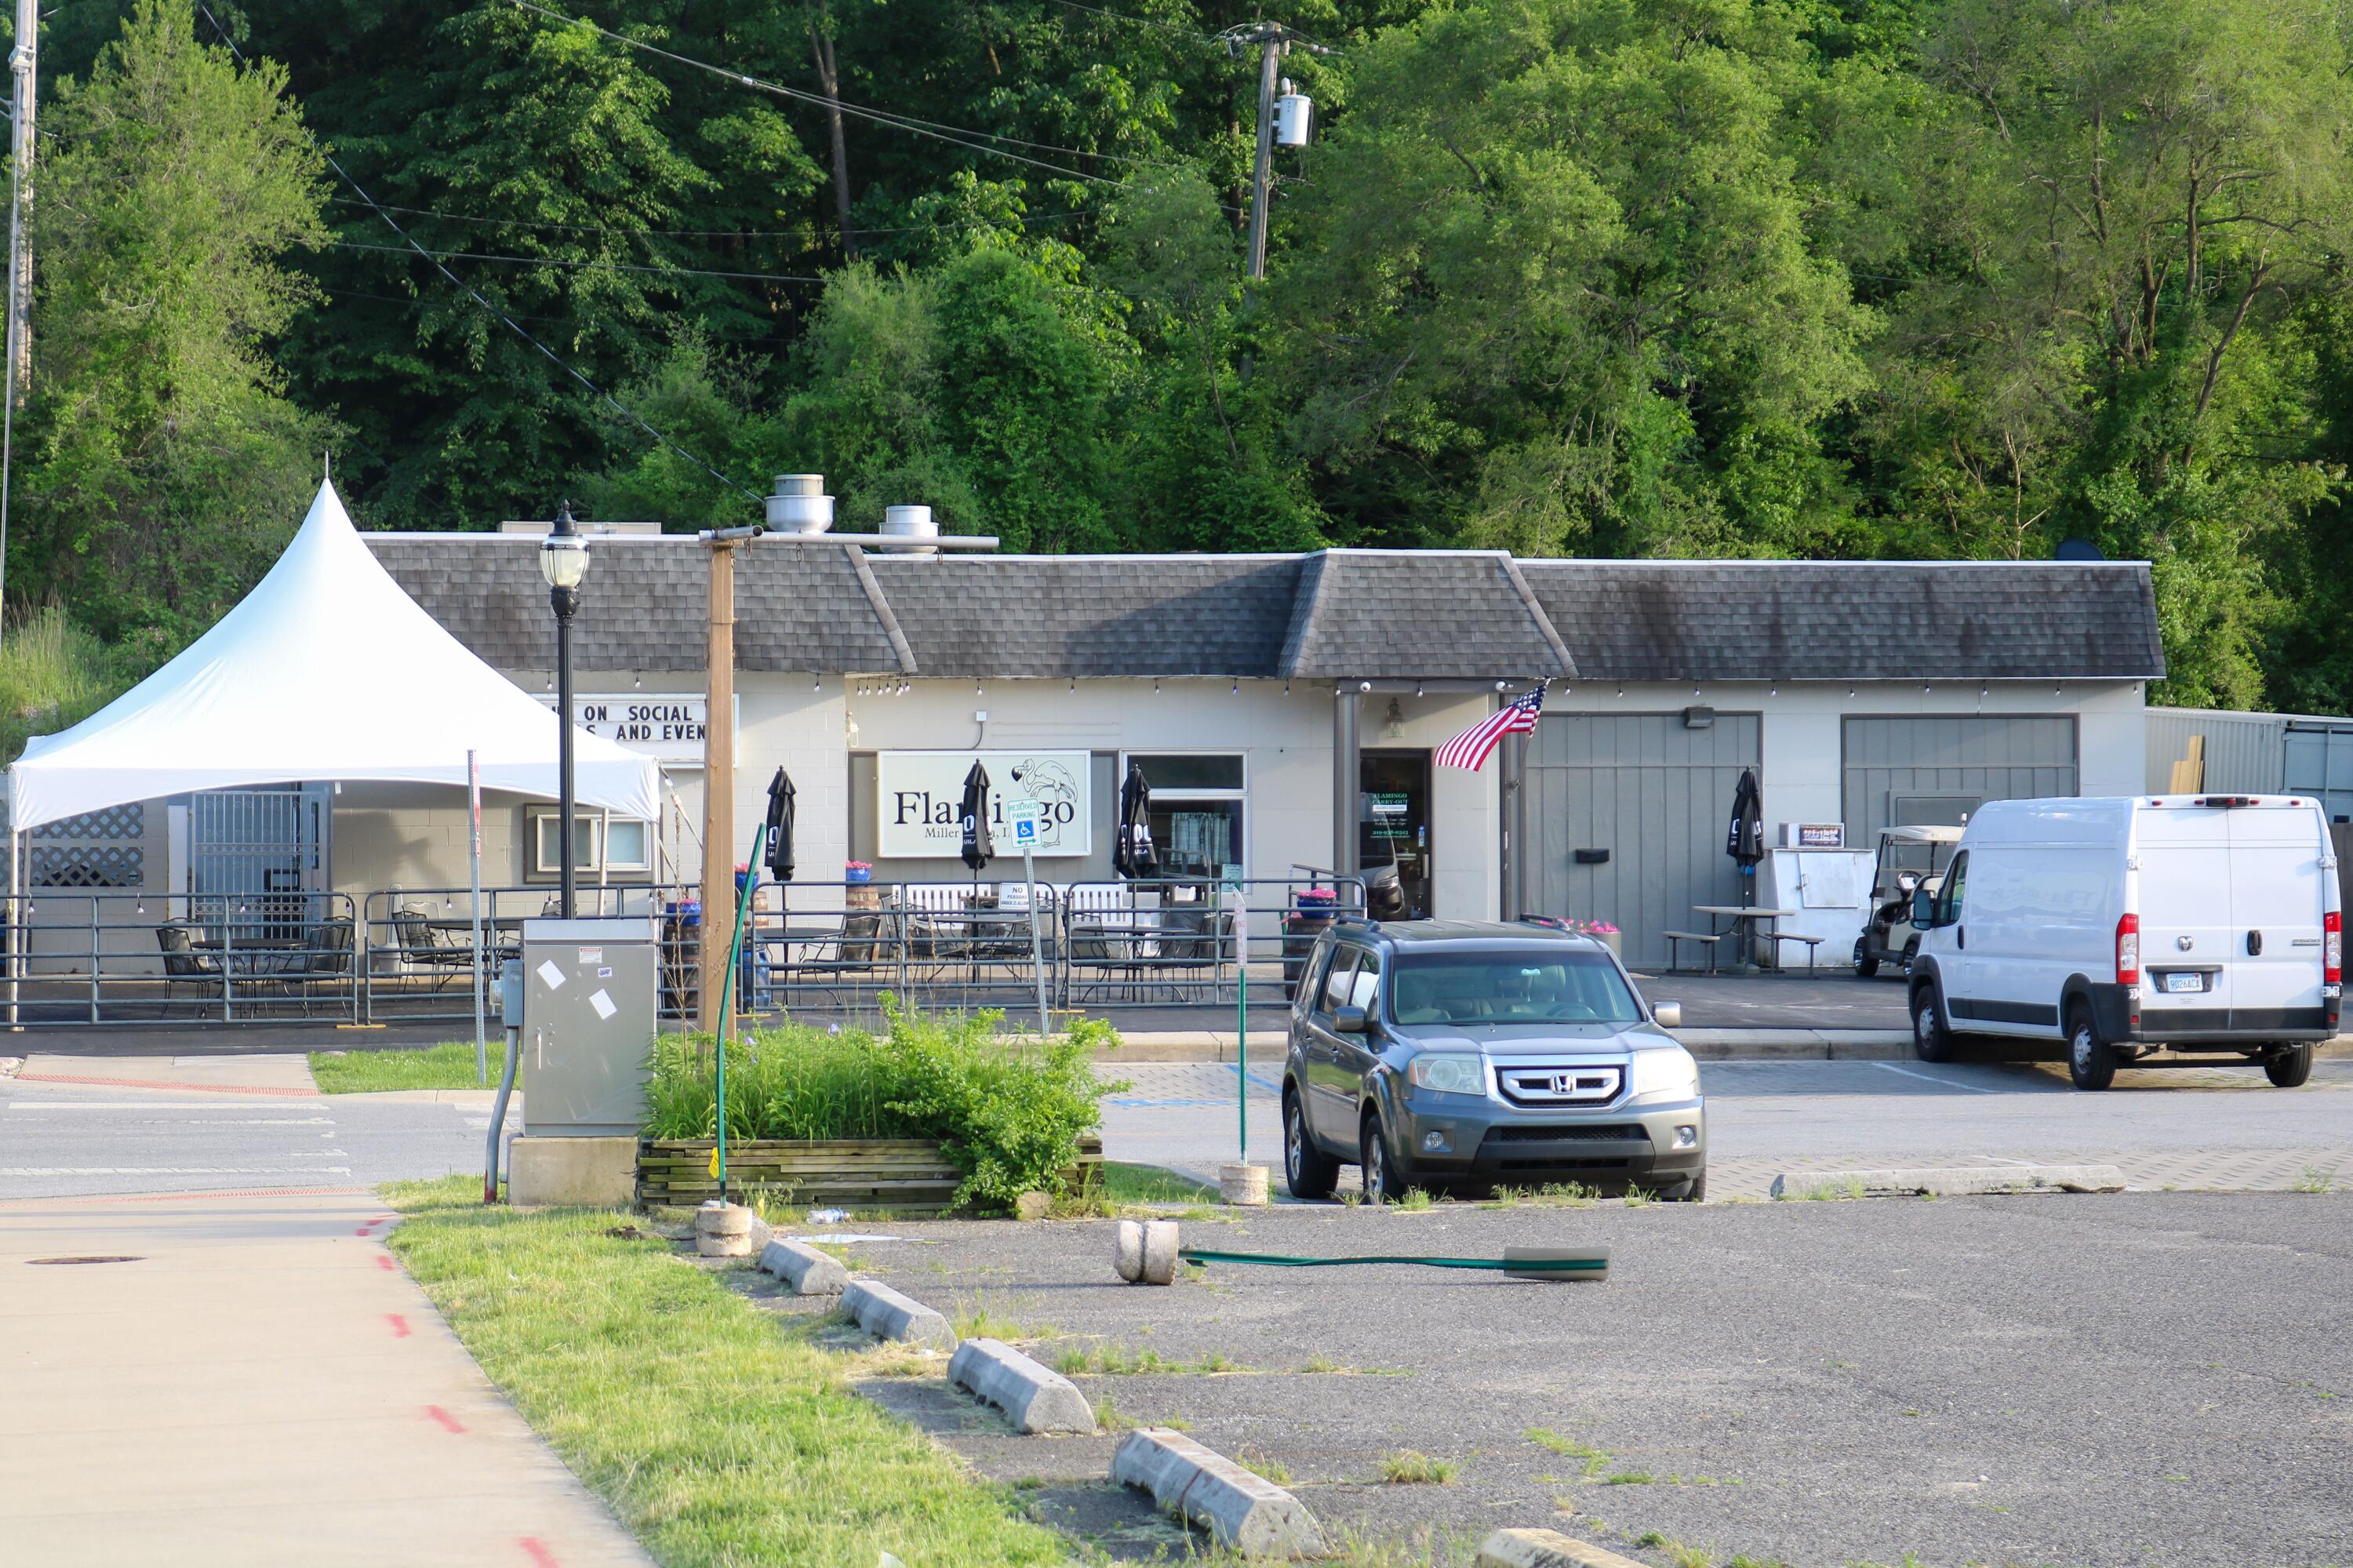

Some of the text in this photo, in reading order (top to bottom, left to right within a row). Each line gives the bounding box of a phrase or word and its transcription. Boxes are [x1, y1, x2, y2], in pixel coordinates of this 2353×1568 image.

[584, 705, 692, 721] ON SOCIAL
[616, 724, 705, 740] AND EVEN
[893, 791, 1075, 832] Flaigo
[1009, 802, 1038, 811] RESERVED
[925, 826, 959, 838] Miller
